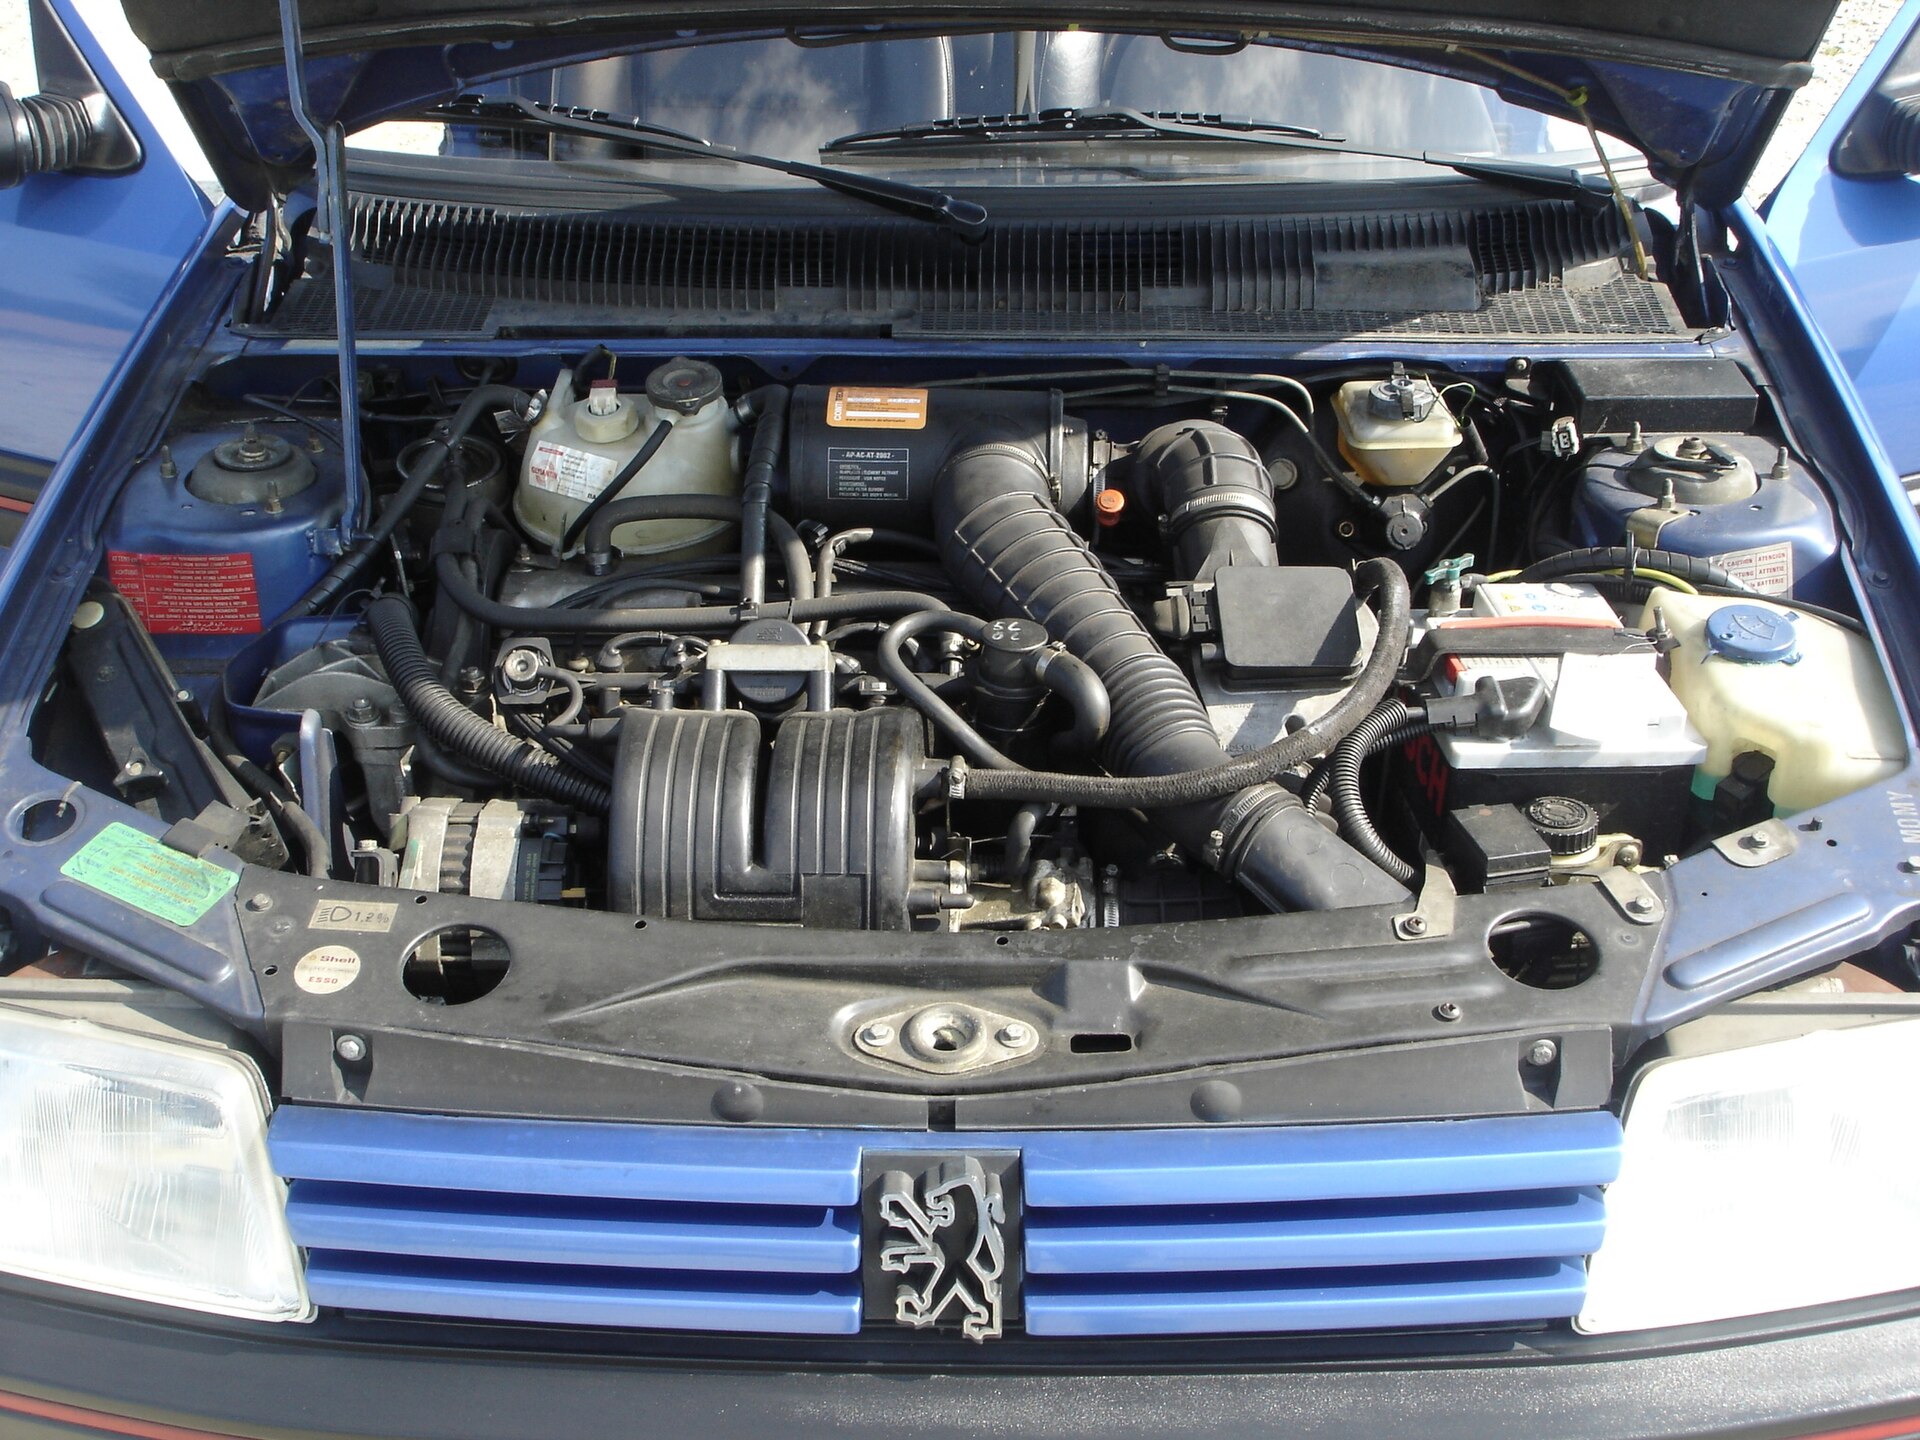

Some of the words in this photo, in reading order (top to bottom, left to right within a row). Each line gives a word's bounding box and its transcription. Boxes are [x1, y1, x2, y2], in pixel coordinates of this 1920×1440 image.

[845, 451, 891, 459] AP-AC-AT-2002
[1758, 552, 1786, 562] ATENCION
[1727, 558, 1753, 567] CAUTION
[1757, 578, 1784, 587] BATTERIE
[320, 955, 356, 964] Shell
[308, 976, 338, 984] ESSO
